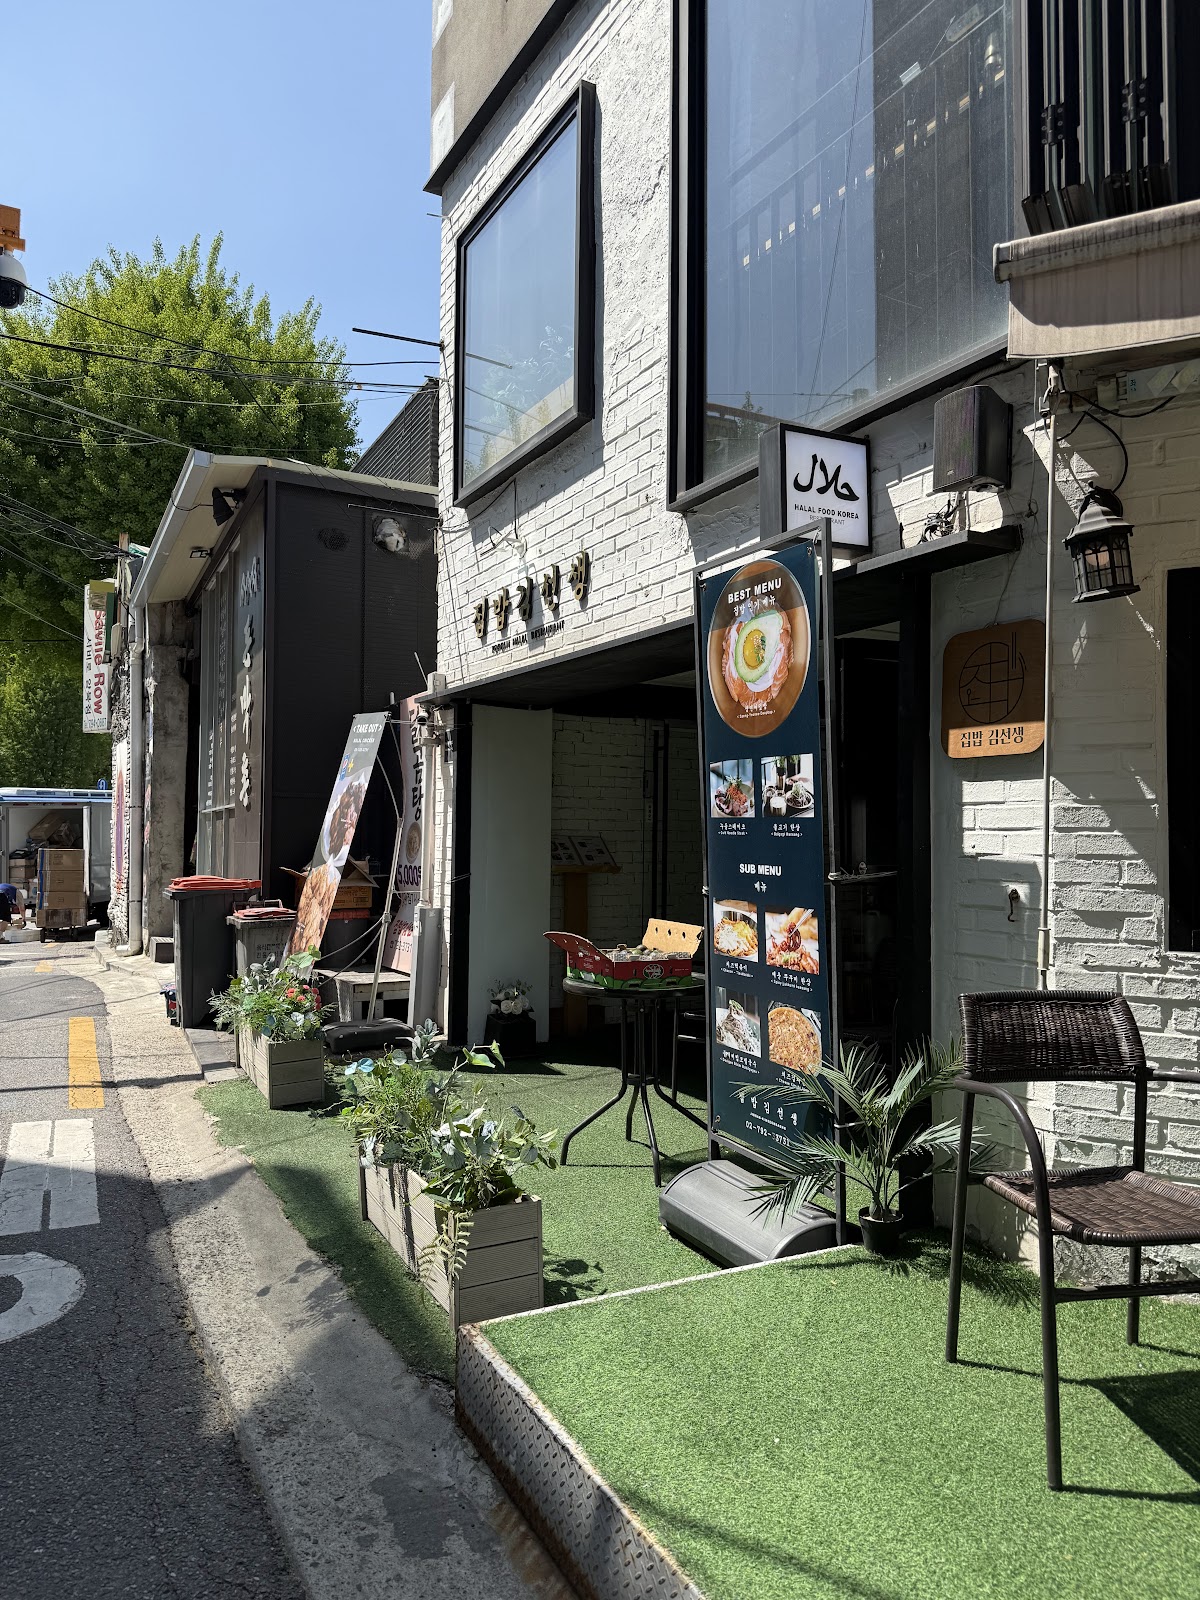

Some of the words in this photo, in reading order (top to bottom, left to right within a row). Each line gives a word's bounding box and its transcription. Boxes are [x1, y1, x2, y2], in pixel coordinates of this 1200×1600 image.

[793, 453, 860, 501] حلال
[794, 503, 816, 514] HALAL
[818, 507, 836, 516] FOOD
[837, 510, 860, 520] KOREA
[727, 587, 751, 604] BEST
[754, 577, 782, 597] MENU
[94, 672, 105, 715] Row
[356, 723, 369, 734] TAKE
[368, 723, 379, 733] OUT
[960, 730, 983, 748] 집밥
[988, 726, 1024, 746] 김선생
[739, 863, 757, 874] SUB
[757, 864, 782, 876] MENU
